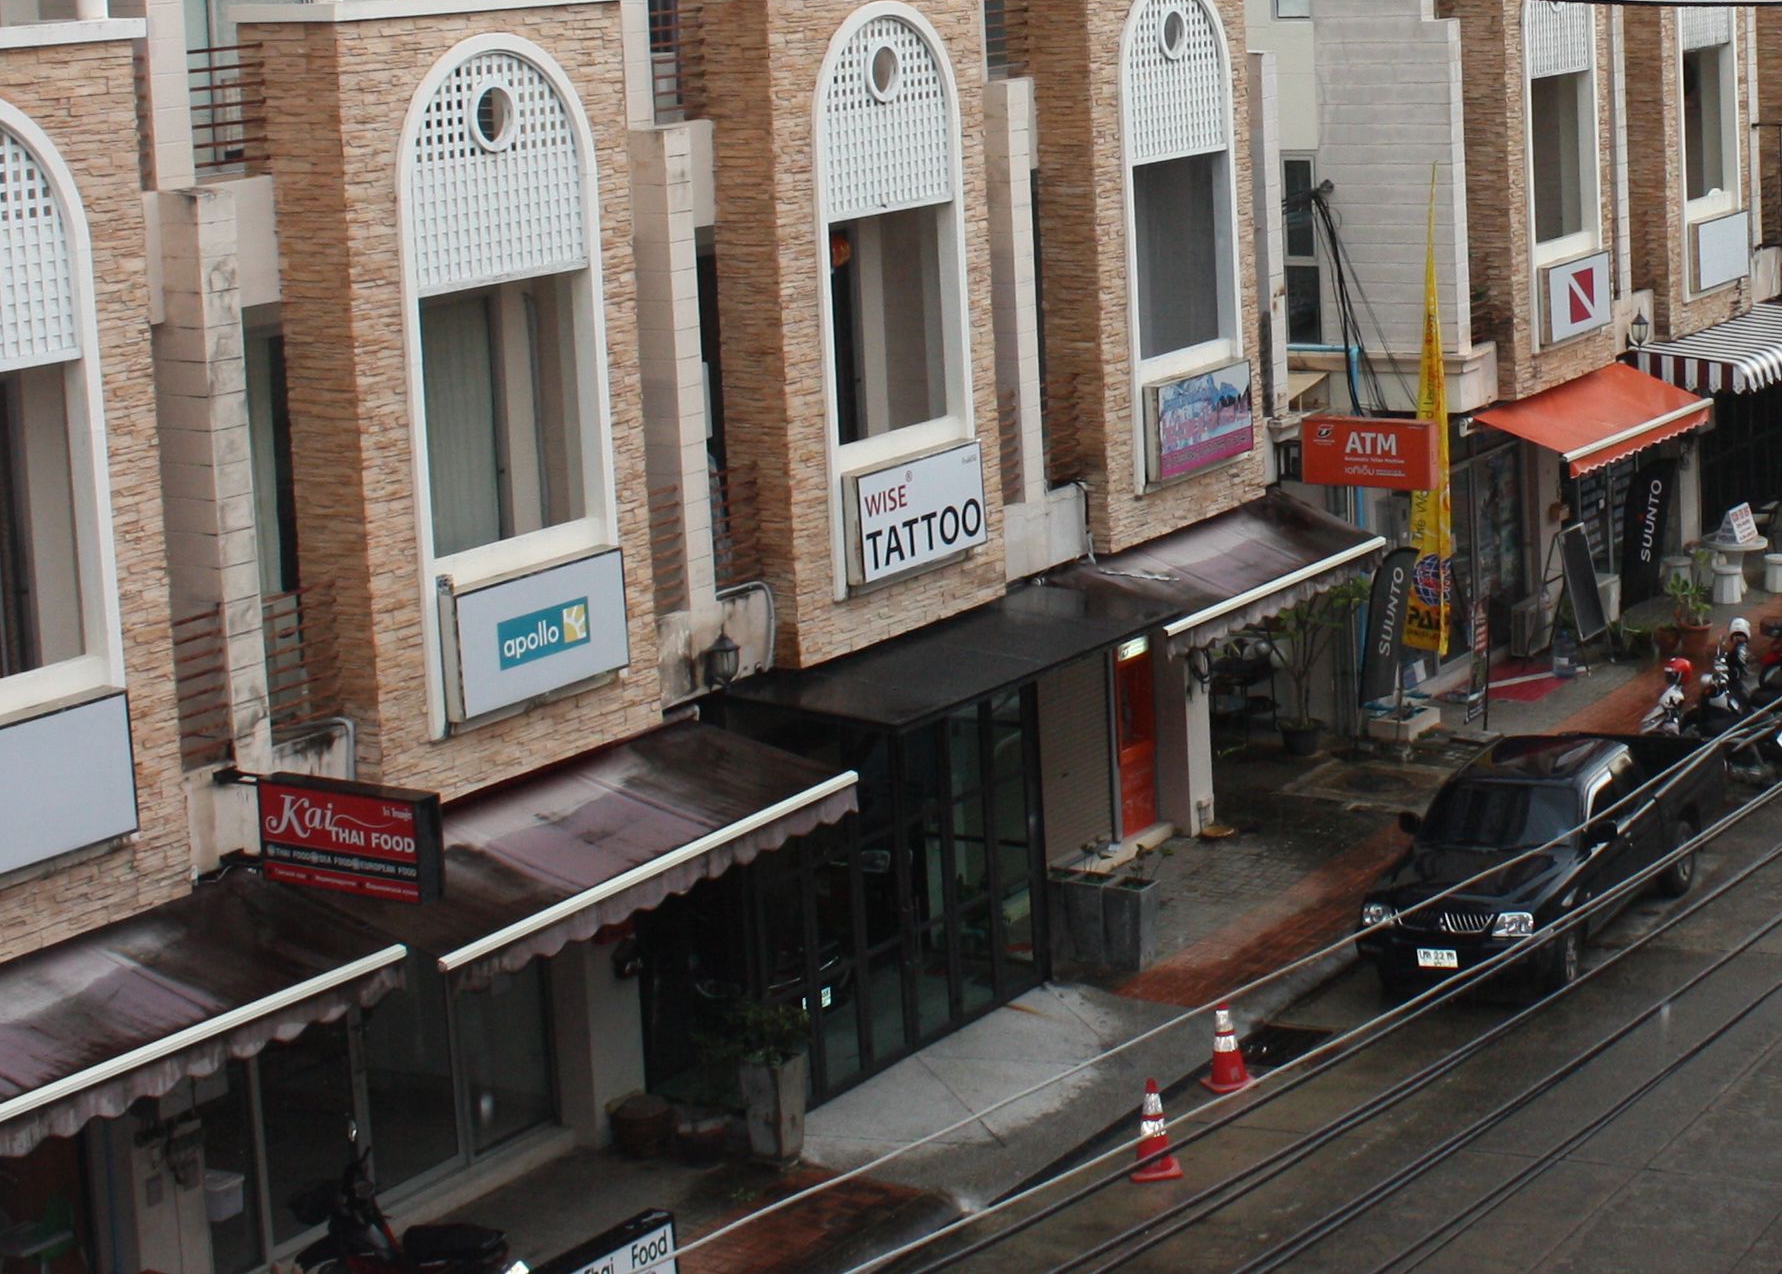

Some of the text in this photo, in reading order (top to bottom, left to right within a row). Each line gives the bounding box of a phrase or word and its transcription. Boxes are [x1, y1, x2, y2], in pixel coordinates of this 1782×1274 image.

[1344, 431, 1397, 456] ATM
[864, 484, 908, 518] WISE
[1641, 479, 1663, 563] SUUNTO
[865, 498, 981, 571] TATTOO
[1379, 567, 1404, 656] SUUNTO
[503, 619, 559, 659] apollo
[265, 794, 334, 839] Kai
[331, 826, 416, 853] THAI FOOD
[584, 1229, 668, 1274] ai Food
